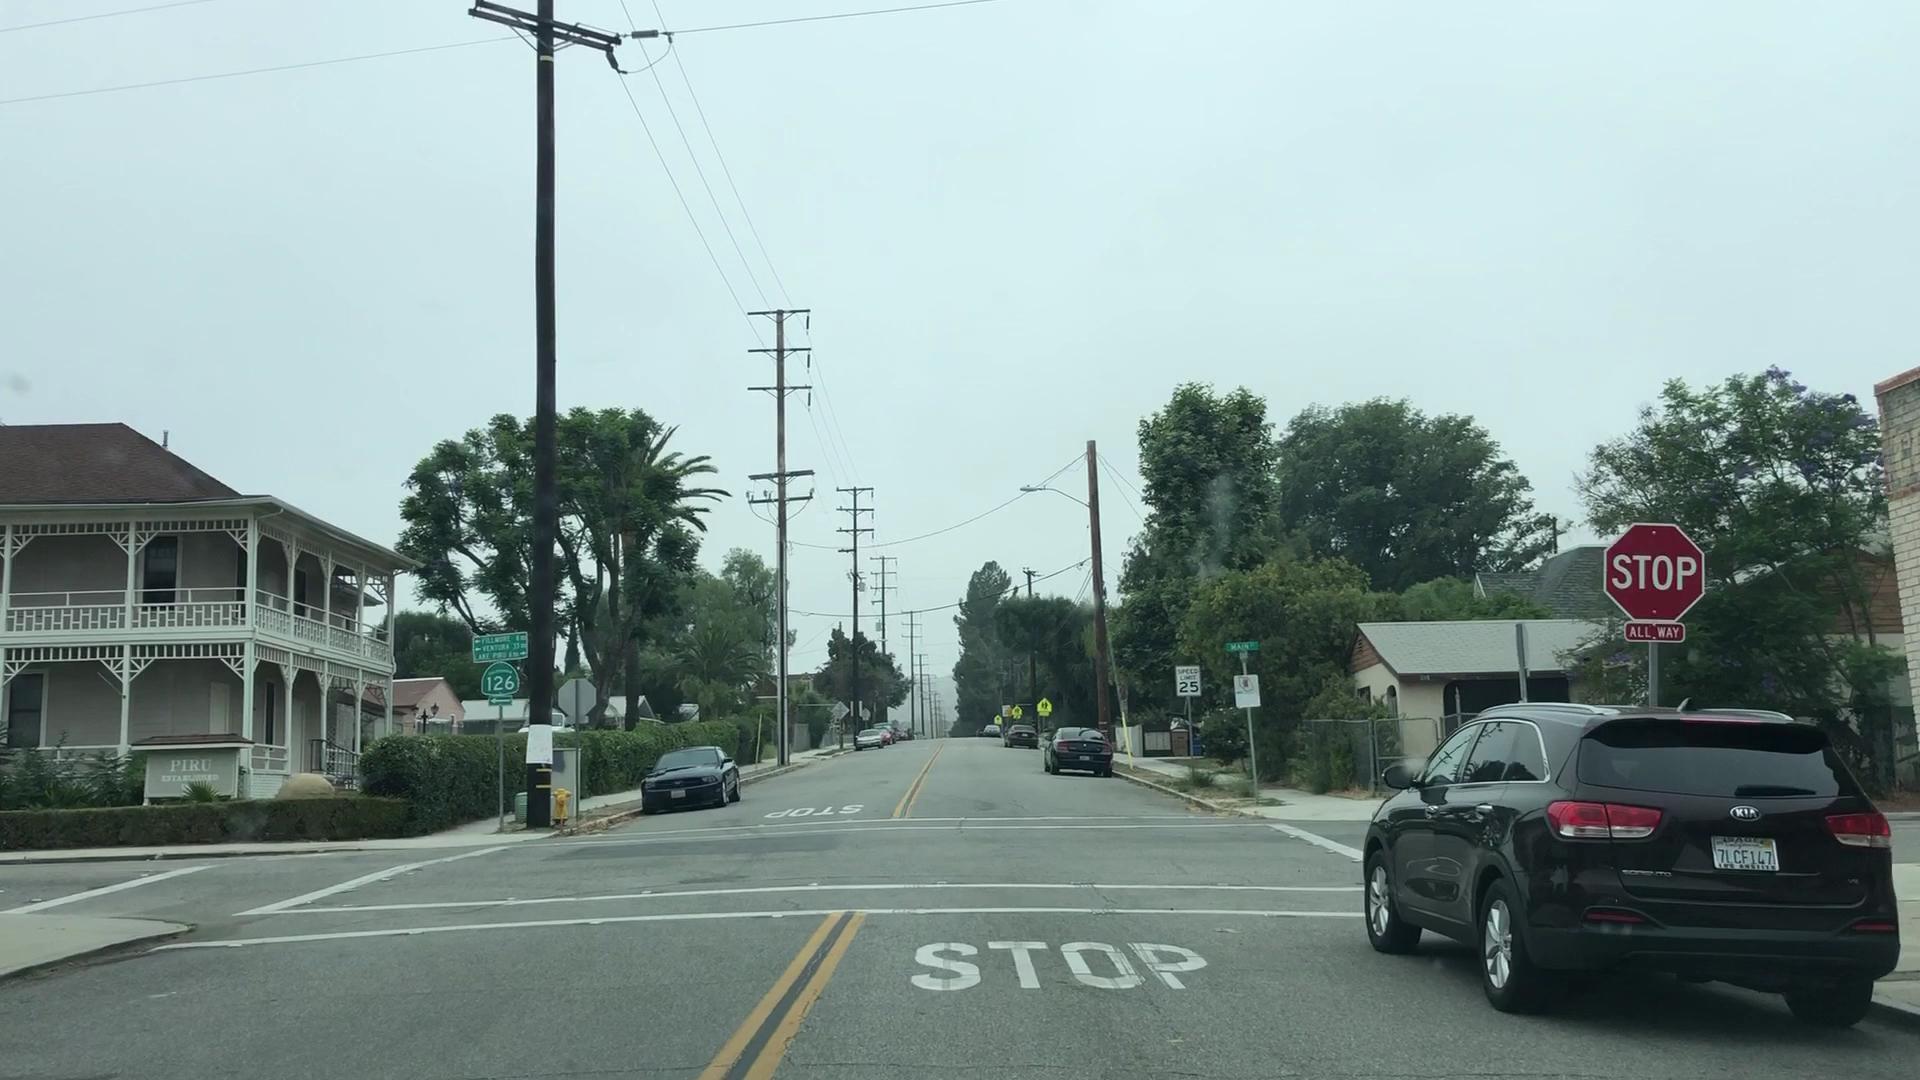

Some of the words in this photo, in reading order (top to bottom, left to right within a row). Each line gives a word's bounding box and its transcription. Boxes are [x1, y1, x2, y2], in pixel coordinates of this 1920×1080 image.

[1611, 554, 1698, 591] STOP
[1629, 626, 1651, 638] ALL
[1657, 626, 1680, 639] WAY
[482, 644, 509, 652] VENTURA
[487, 675, 515, 691] 126
[1179, 681, 1199, 693] 25
[170, 759, 212, 772] PIRU
[763, 804, 865, 819] STOP
[1735, 808, 1758, 818] KIA
[910, 941, 1208, 991] STOP
